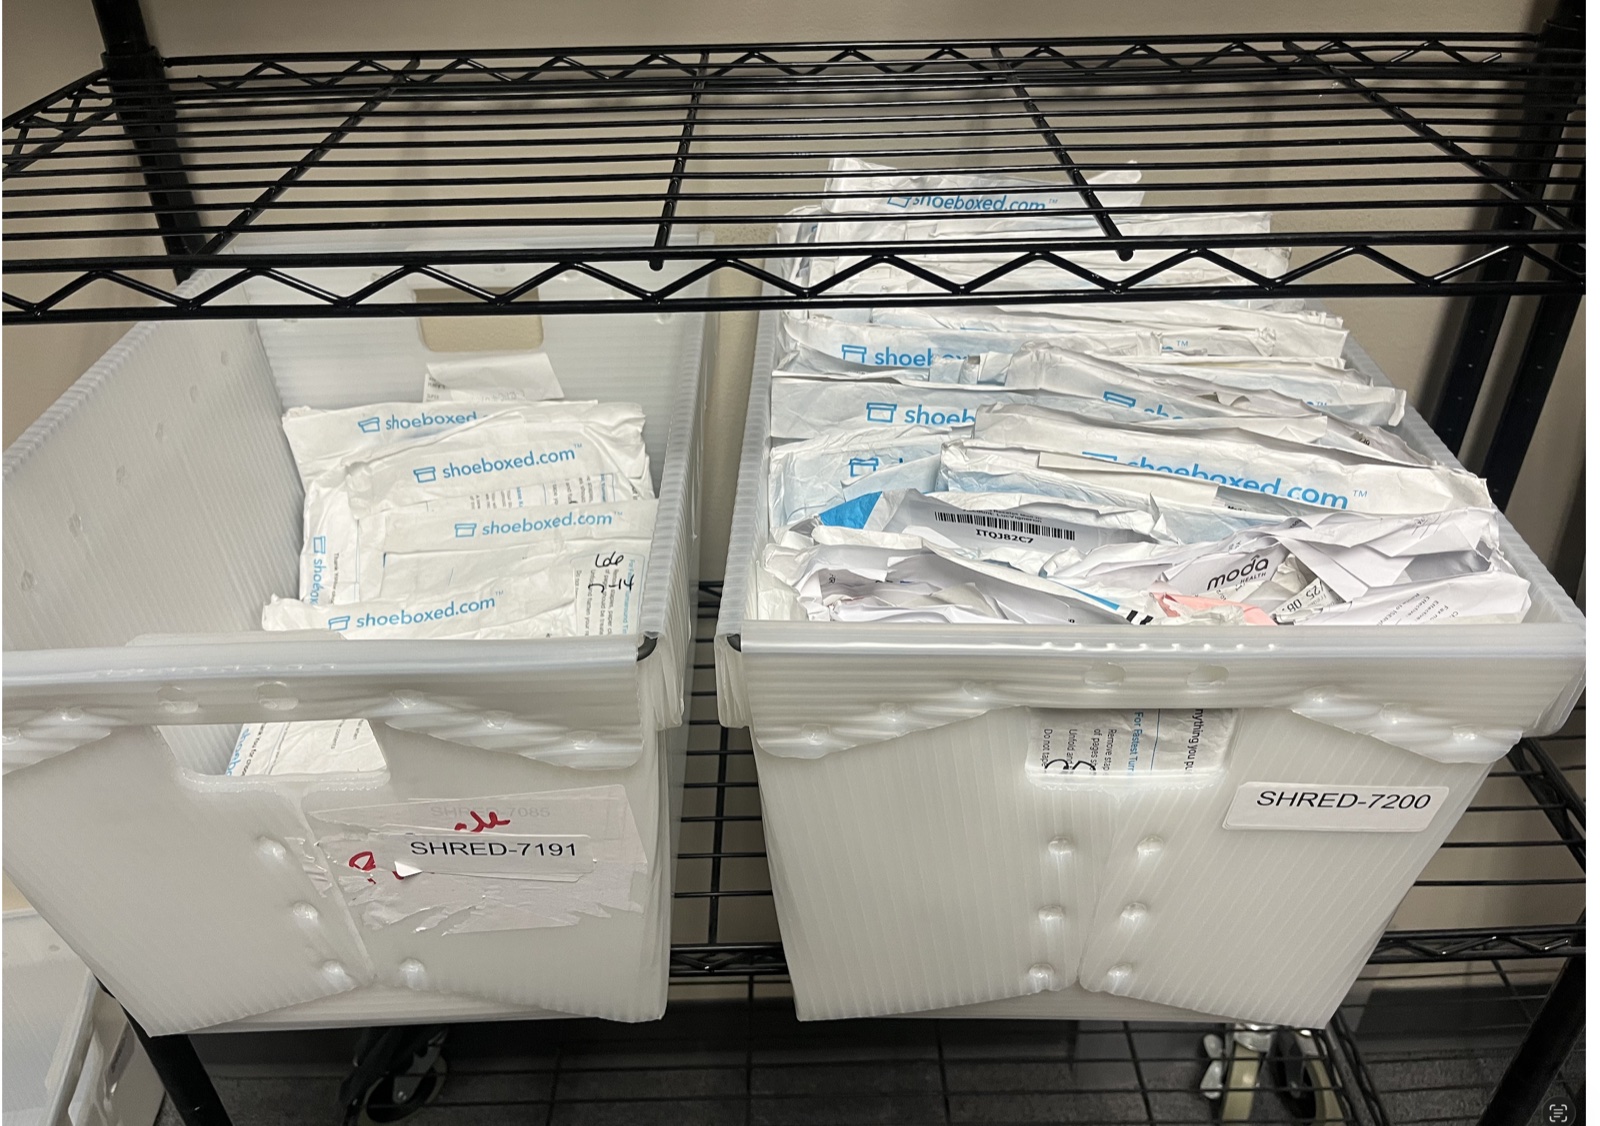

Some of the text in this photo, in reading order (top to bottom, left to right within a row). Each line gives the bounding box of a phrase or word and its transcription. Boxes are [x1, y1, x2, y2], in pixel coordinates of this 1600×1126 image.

[443, 448, 575, 478] shoeboxed.com
[482, 512, 612, 535] shoeboxed.com
[1207, 555, 1269, 591] moda
[356, 598, 496, 628] shoeboxed.com
[1134, 711, 1144, 728] For
[1130, 729, 1143, 755] Fastest
[1256, 790, 1432, 810] SHRED-7200
[410, 841, 577, 857] SHRED-7191
